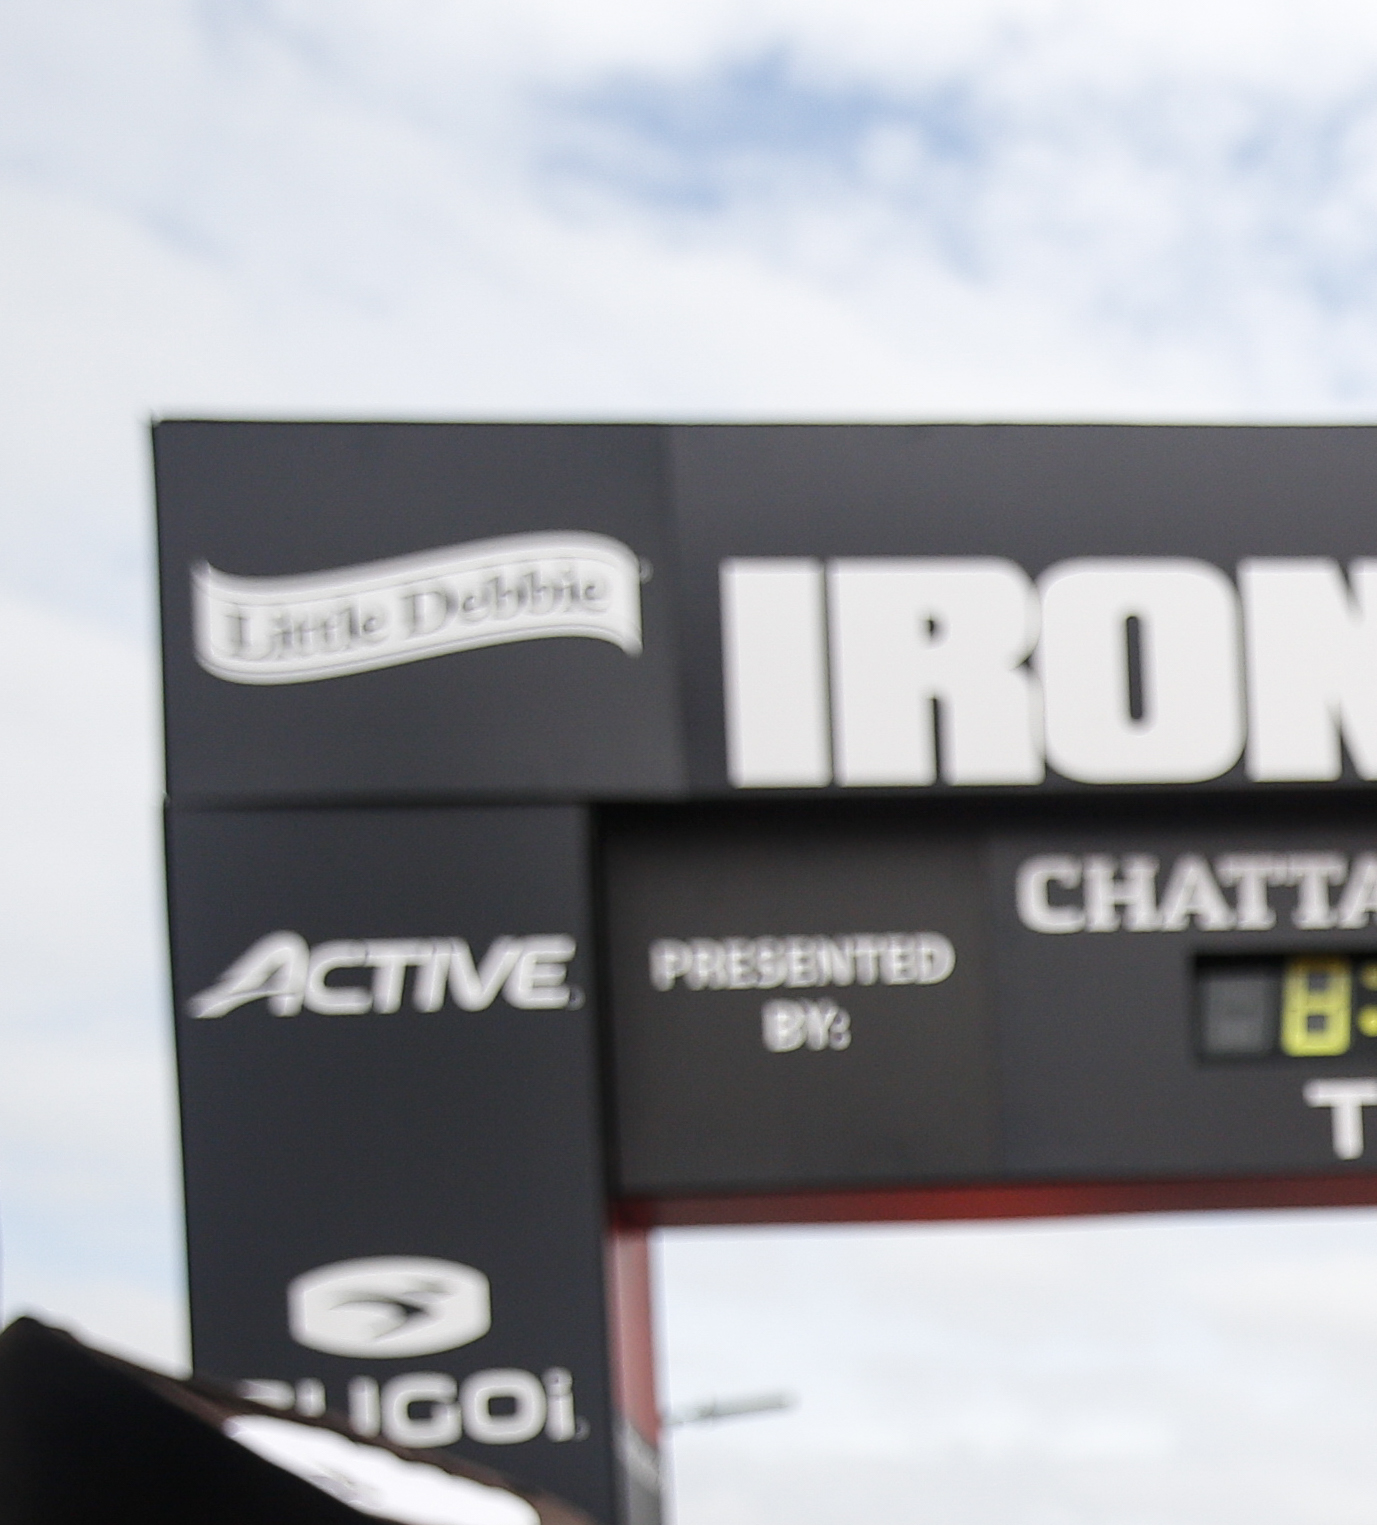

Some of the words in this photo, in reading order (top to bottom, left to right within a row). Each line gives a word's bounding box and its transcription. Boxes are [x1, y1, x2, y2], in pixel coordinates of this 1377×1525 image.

[224, 606, 388, 664] Little
[399, 562, 609, 638] Debbie
[193, 931, 574, 1018] ACTIVE
[650, 932, 956, 990] PRESENTED
[761, 998, 852, 1053] BY:
